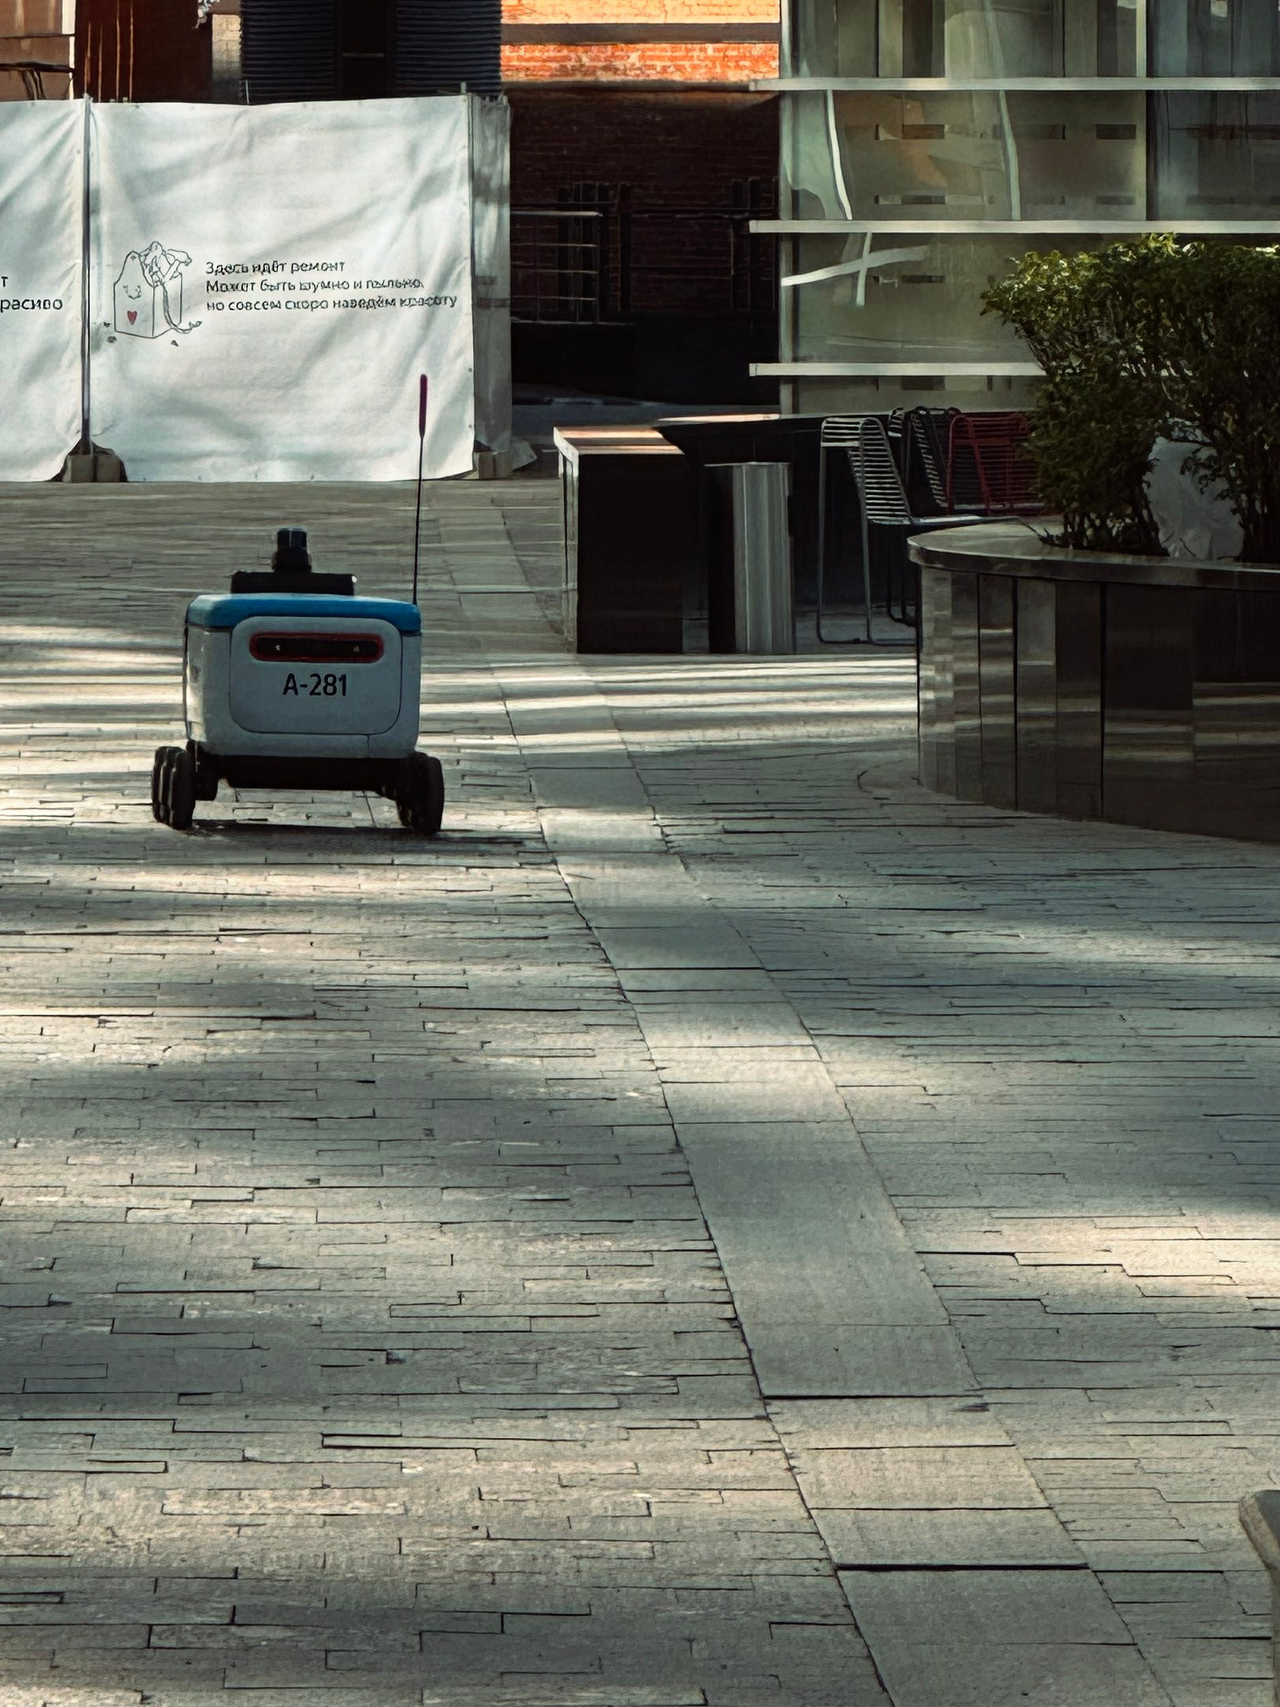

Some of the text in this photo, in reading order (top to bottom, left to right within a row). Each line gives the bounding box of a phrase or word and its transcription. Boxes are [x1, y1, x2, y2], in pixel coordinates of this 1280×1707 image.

[205, 260, 345, 275] Здесь идёт ремонт
[206, 279, 256, 293] Может
[260, 279, 296, 291] быть
[299, 280, 350, 293] шумно
[353, 280, 362, 289] и
[207, 301, 225, 311] но
[228, 300, 282, 311] совсем
[285, 299, 329, 312] скоро
[333, 295, 396, 310] наведём
[283, 673, 347, 696] A-281
